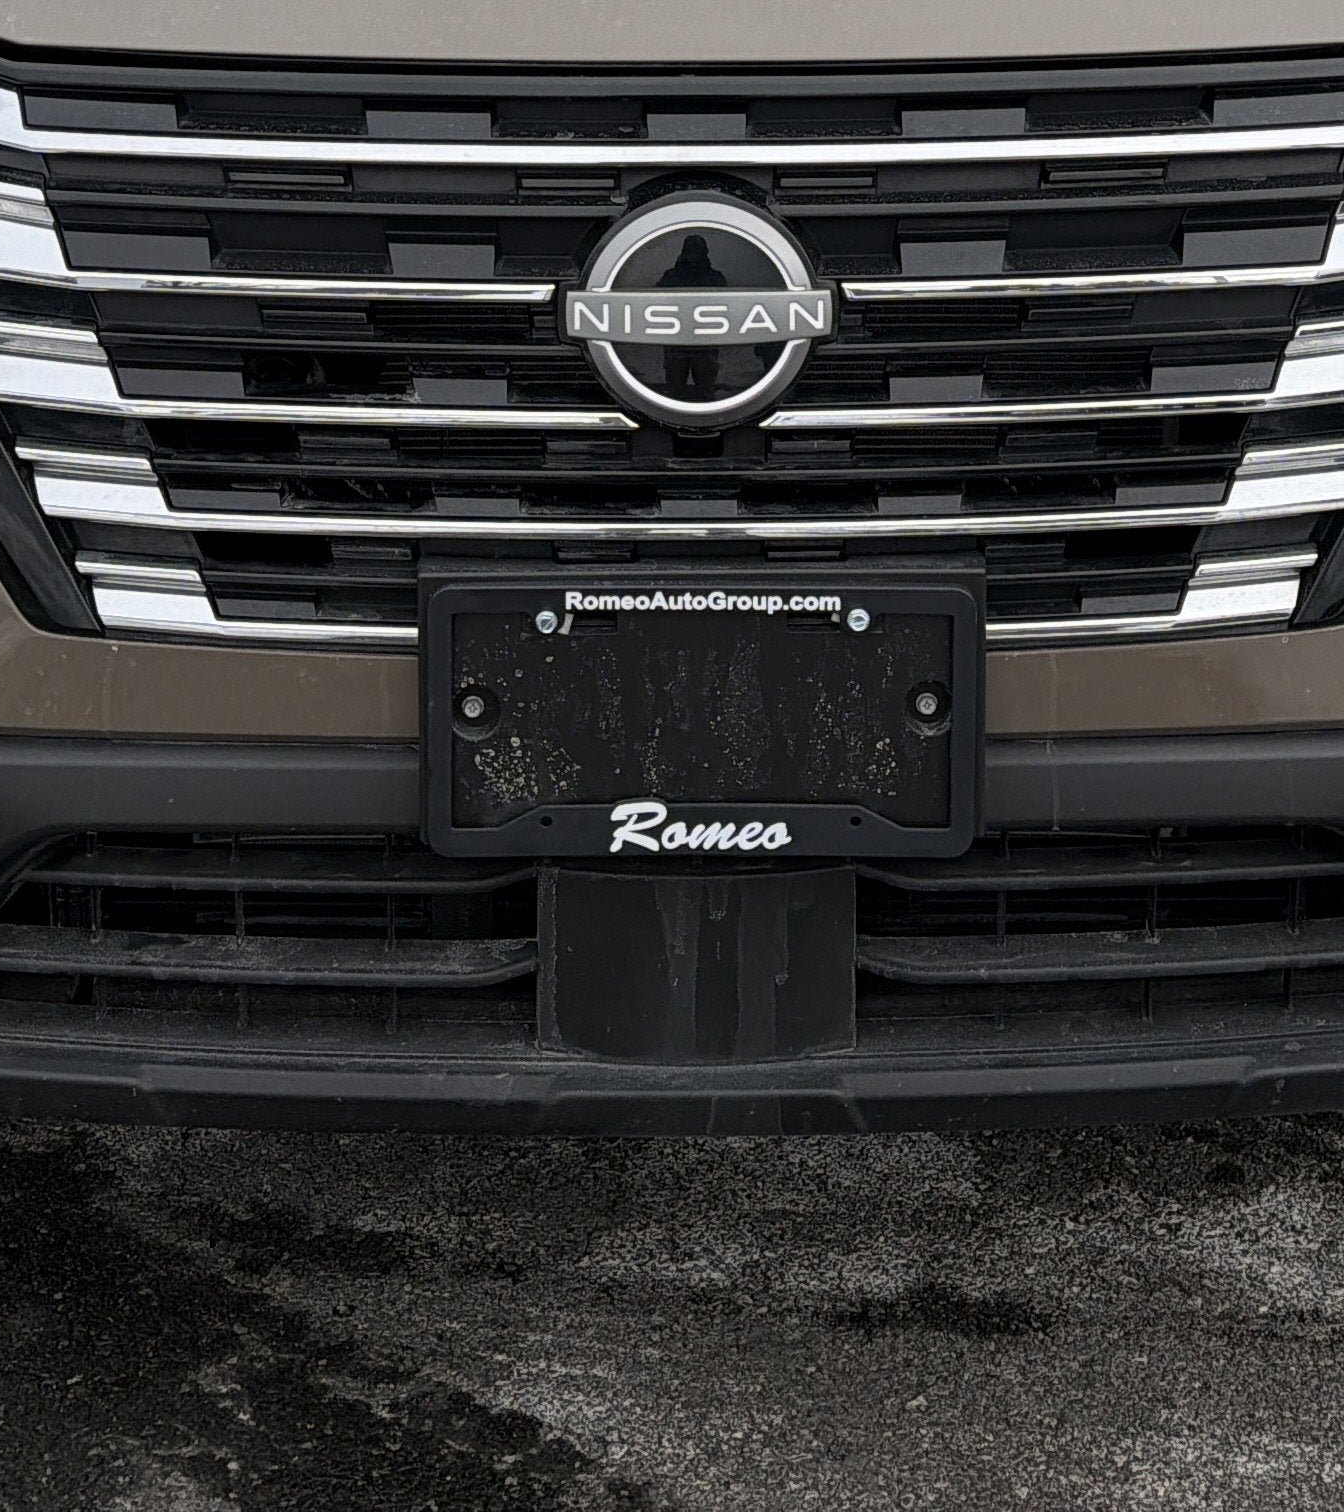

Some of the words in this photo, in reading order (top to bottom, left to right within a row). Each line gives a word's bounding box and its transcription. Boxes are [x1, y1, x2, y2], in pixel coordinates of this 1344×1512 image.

[574, 299, 824, 335] NISSAN
[565, 591, 842, 614] RomeoAutoGroup.com
[609, 801, 792, 853] Romeo
